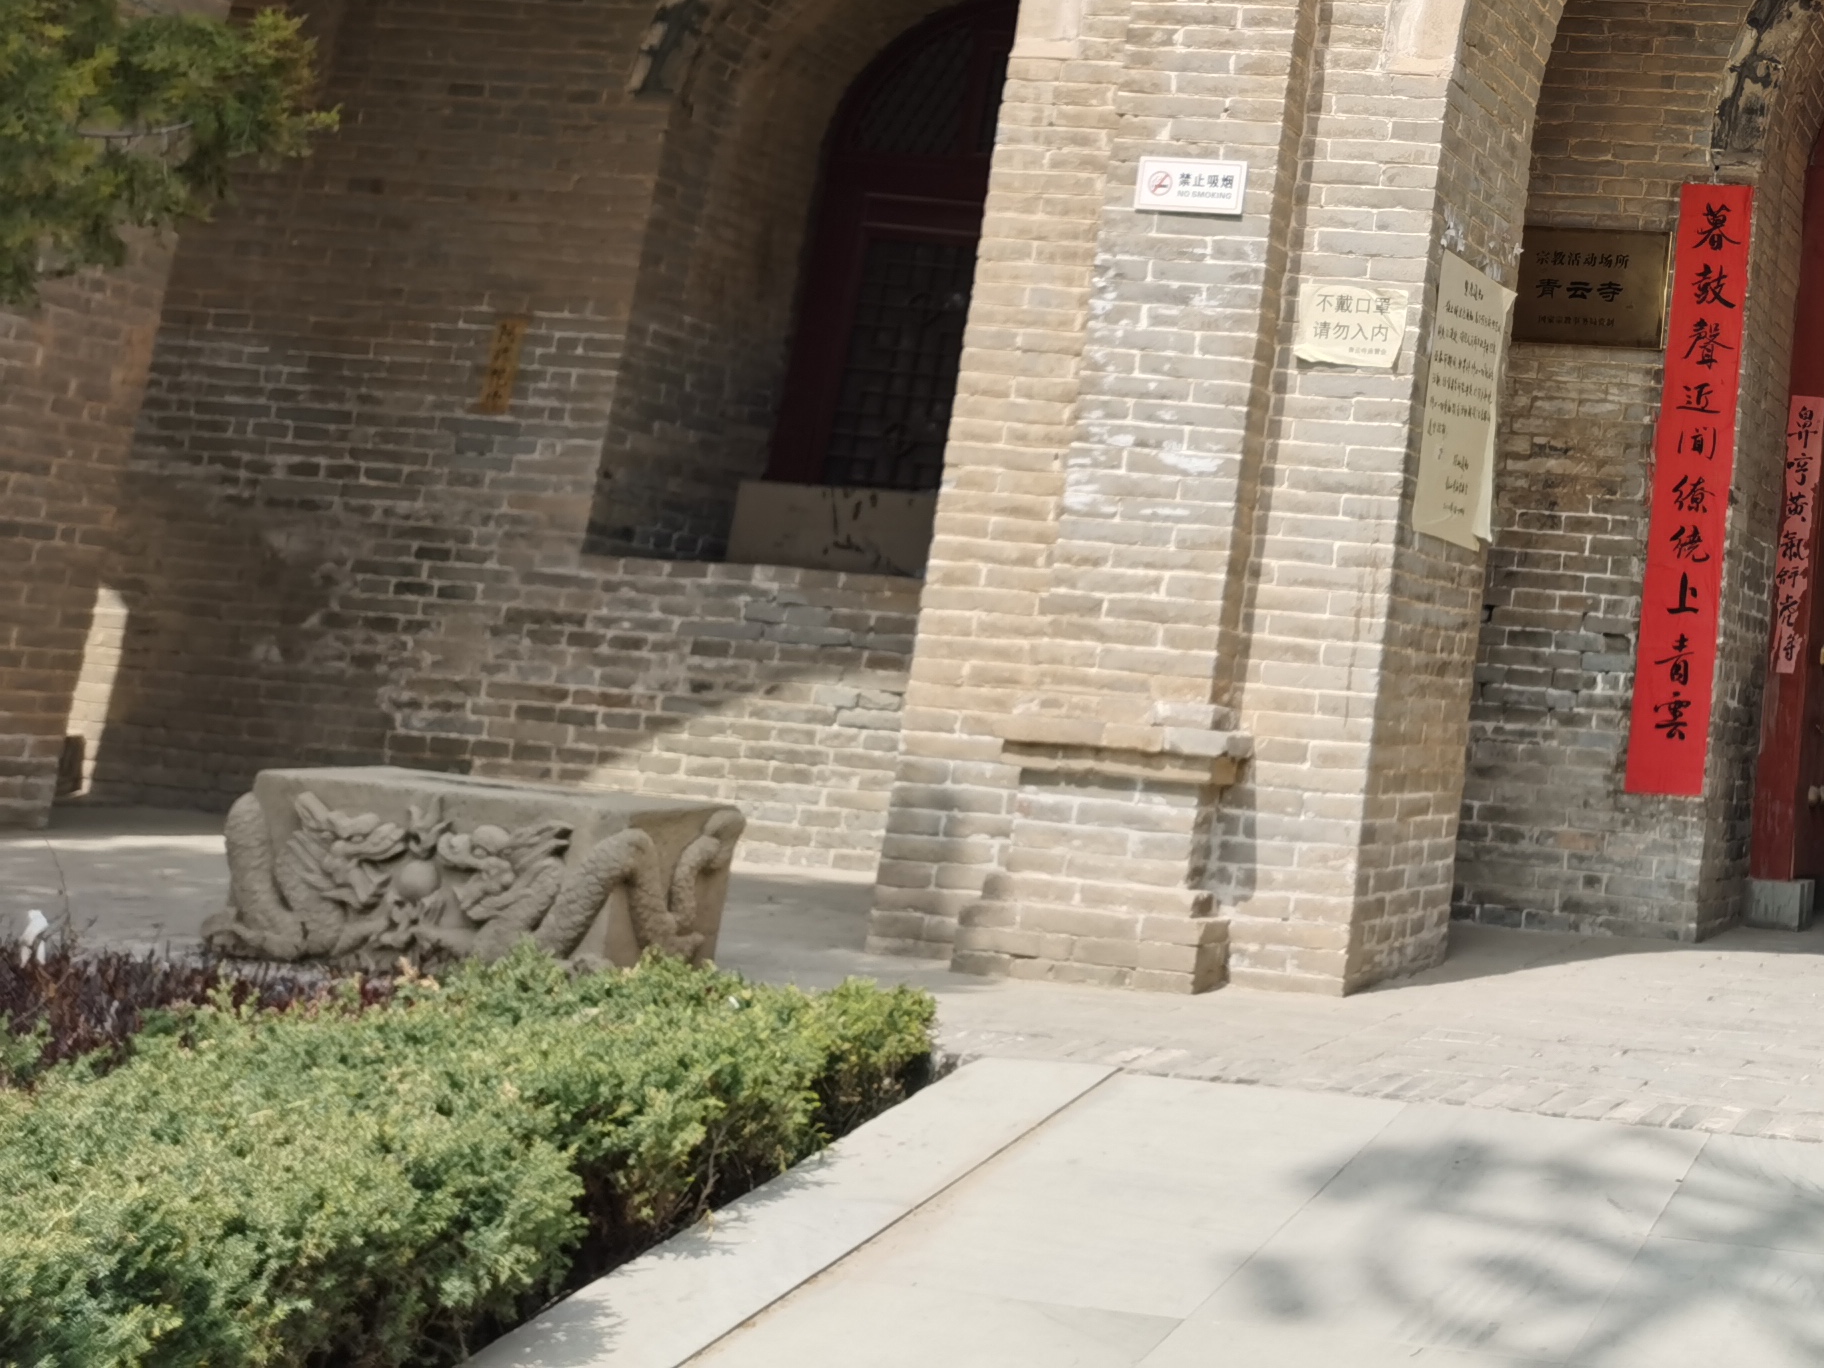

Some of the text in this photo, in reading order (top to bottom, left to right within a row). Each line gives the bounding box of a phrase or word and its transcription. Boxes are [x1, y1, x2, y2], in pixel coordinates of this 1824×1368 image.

[1178, 172, 1235, 190] 禁止吸烟
[1177, 190, 1233, 200] NO SMOKING
[1536, 250, 1630, 270] 宗教活动场所
[1535, 278, 1624, 303] 青云寺
[1314, 294, 1392, 316] 不戴口罩
[1312, 321, 1390, 343] 请勿入内
